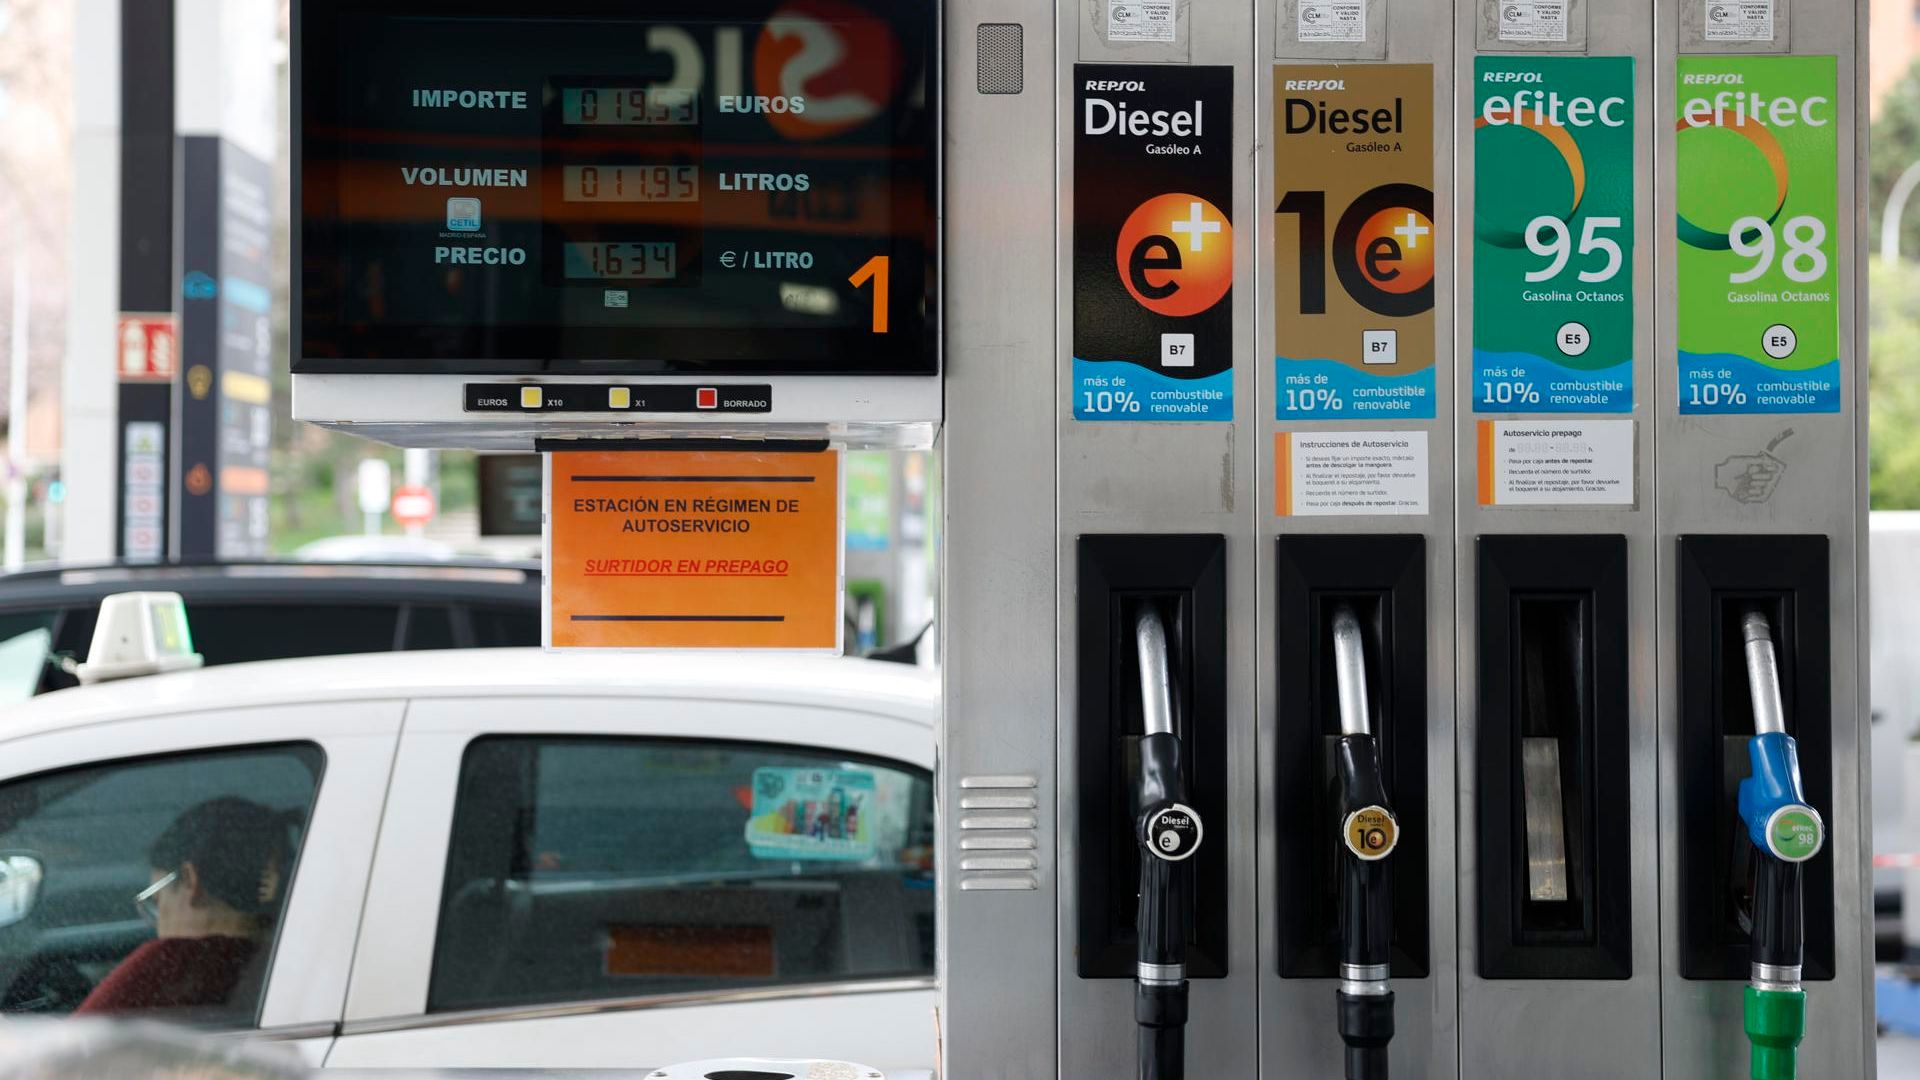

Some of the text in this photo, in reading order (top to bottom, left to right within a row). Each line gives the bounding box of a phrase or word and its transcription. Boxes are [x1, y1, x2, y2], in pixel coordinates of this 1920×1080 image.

[1483, 72, 1543, 82] REPSOL
[1683, 74, 1744, 84] REPSOL
[1085, 80, 1146, 91] REPSOL
[1285, 80, 1345, 90] REPSOL
[413, 90, 527, 108] IMPORTE
[720, 96, 805, 114] EUROS
[1483, 90, 1625, 126] efitec
[1684, 91, 1828, 128] efitec
[1086, 98, 1202, 136] Diesel
[1286, 98, 1402, 134] Diesel
[1146, 144, 1201, 154] Gasóleo A
[1346, 142, 1402, 152] Gasóleo A
[401, 167, 527, 187] VOLUMEN
[720, 173, 809, 192] LITROS
[1275, 183, 1434, 317] 10
[1524, 215, 1622, 282] 95
[1729, 216, 1828, 283] 98
[435, 247, 526, 265] PRECIO
[720, 251, 813, 269] € / LITRO
[848, 256, 889, 333] 1
[1522, 290, 1624, 302] Gasolina Octanos
[1728, 291, 1830, 303] Gasolina Octanos
[1566, 334, 1581, 344] E5
[1772, 337, 1787, 347] E5
[1170, 345, 1185, 355] B7
[1372, 342, 1388, 352] B7
[1483, 367, 1525, 377] más de
[1689, 369, 1732, 379] más de
[1083, 376, 1125, 386] más de
[1286, 374, 1328, 384] más de
[1550, 380, 1623, 391] combustible
[1757, 380, 1830, 391] combustible
[1151, 389, 1223, 400] combustible
[1353, 386, 1425, 397] combustible
[1483, 382, 1540, 403] 10%
[1689, 384, 1746, 405] 10%
[478, 399, 508, 407] EUROS
[724, 400, 767, 408] BORRADO
[1083, 392, 1140, 413] 10%
[1286, 389, 1342, 411] 10%
[1550, 394, 1608, 404] renovable
[1757, 393, 1816, 404] renovable
[1151, 403, 1208, 413] renovable
[1353, 400, 1411, 410] renovable
[1300, 440, 1349, 448] Instrucciones
[574, 496, 799, 513] ESTACIÓN EN RÉGIMEN DE
[622, 519, 750, 533] AUTOSERVICIO
[585, 560, 788, 573] SURTIDOR EN PREPAGO
[1162, 816, 1189, 825] Diesel
[1358, 814, 1384, 823] Diesel
[1358, 828, 1387, 849] 10
[1798, 834, 1814, 844] 98
